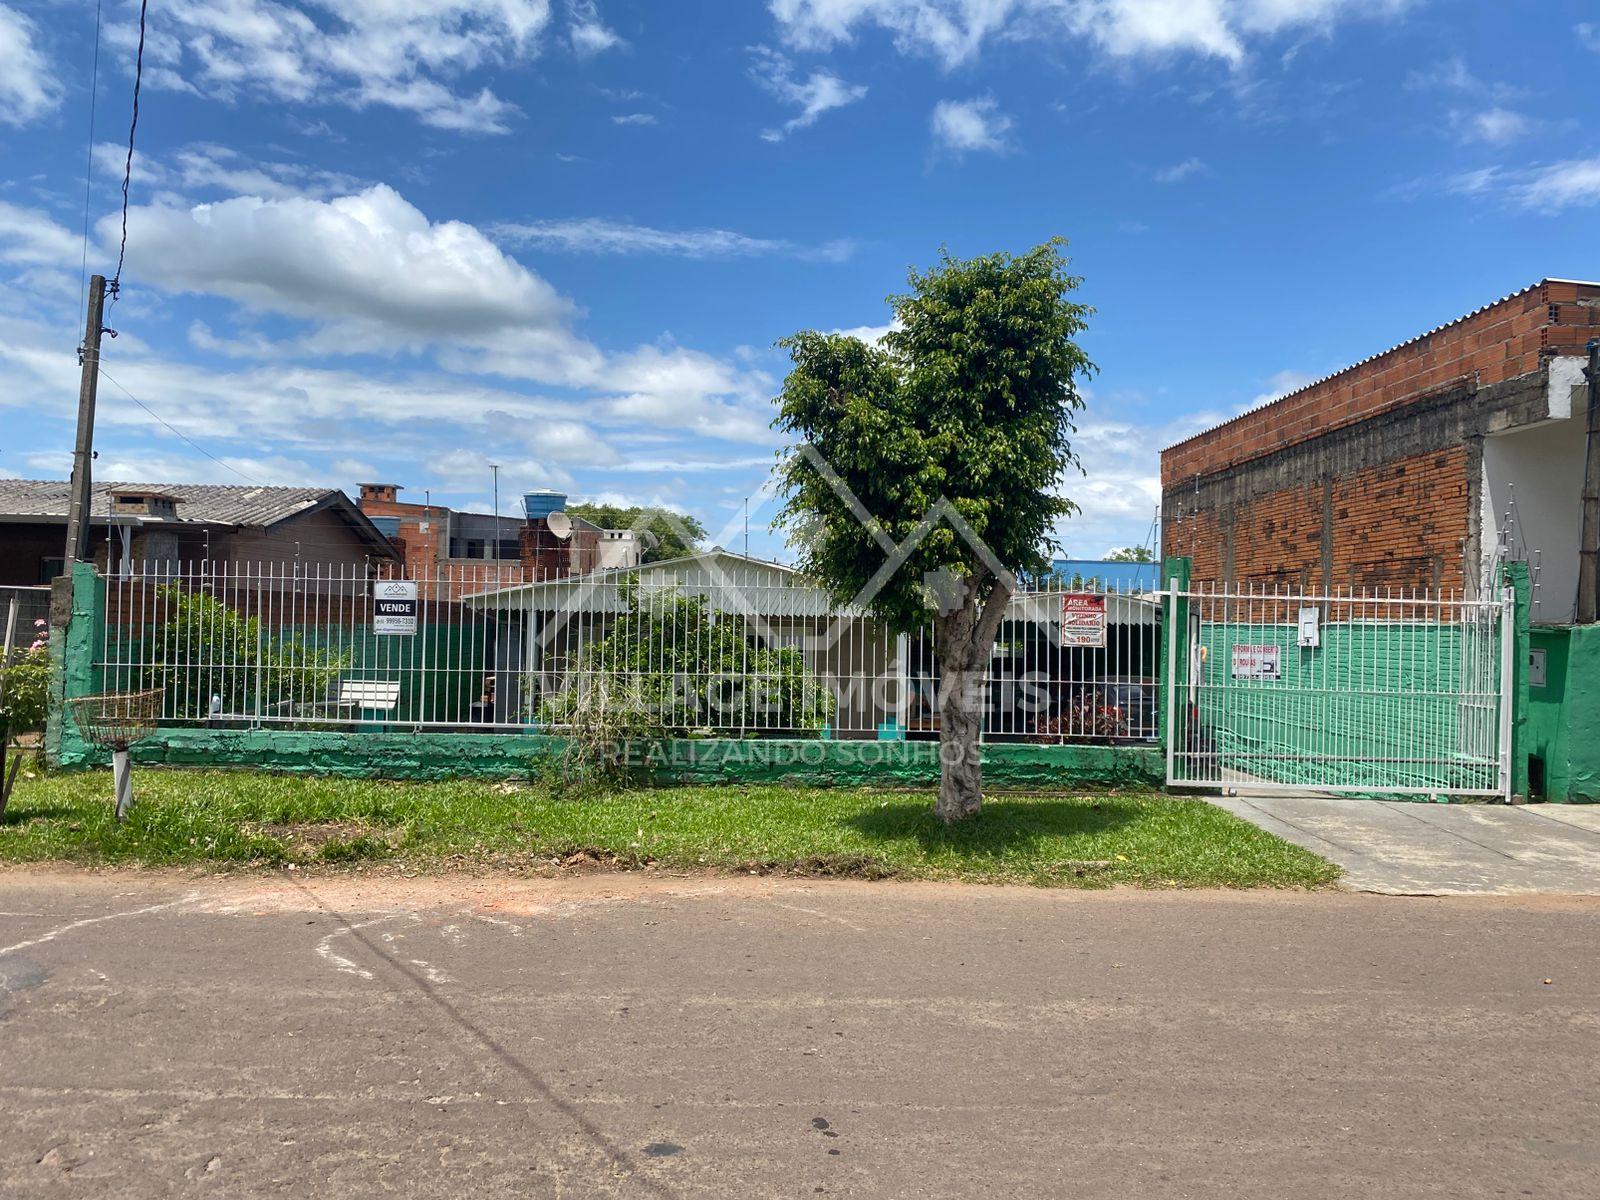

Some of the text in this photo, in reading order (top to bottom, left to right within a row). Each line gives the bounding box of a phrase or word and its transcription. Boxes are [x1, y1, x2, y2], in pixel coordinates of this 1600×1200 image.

[380, 604, 411, 612] VENDE
[1232, 645, 1252, 653] RFORM
[1239, 658, 1256, 666] ROUAS
